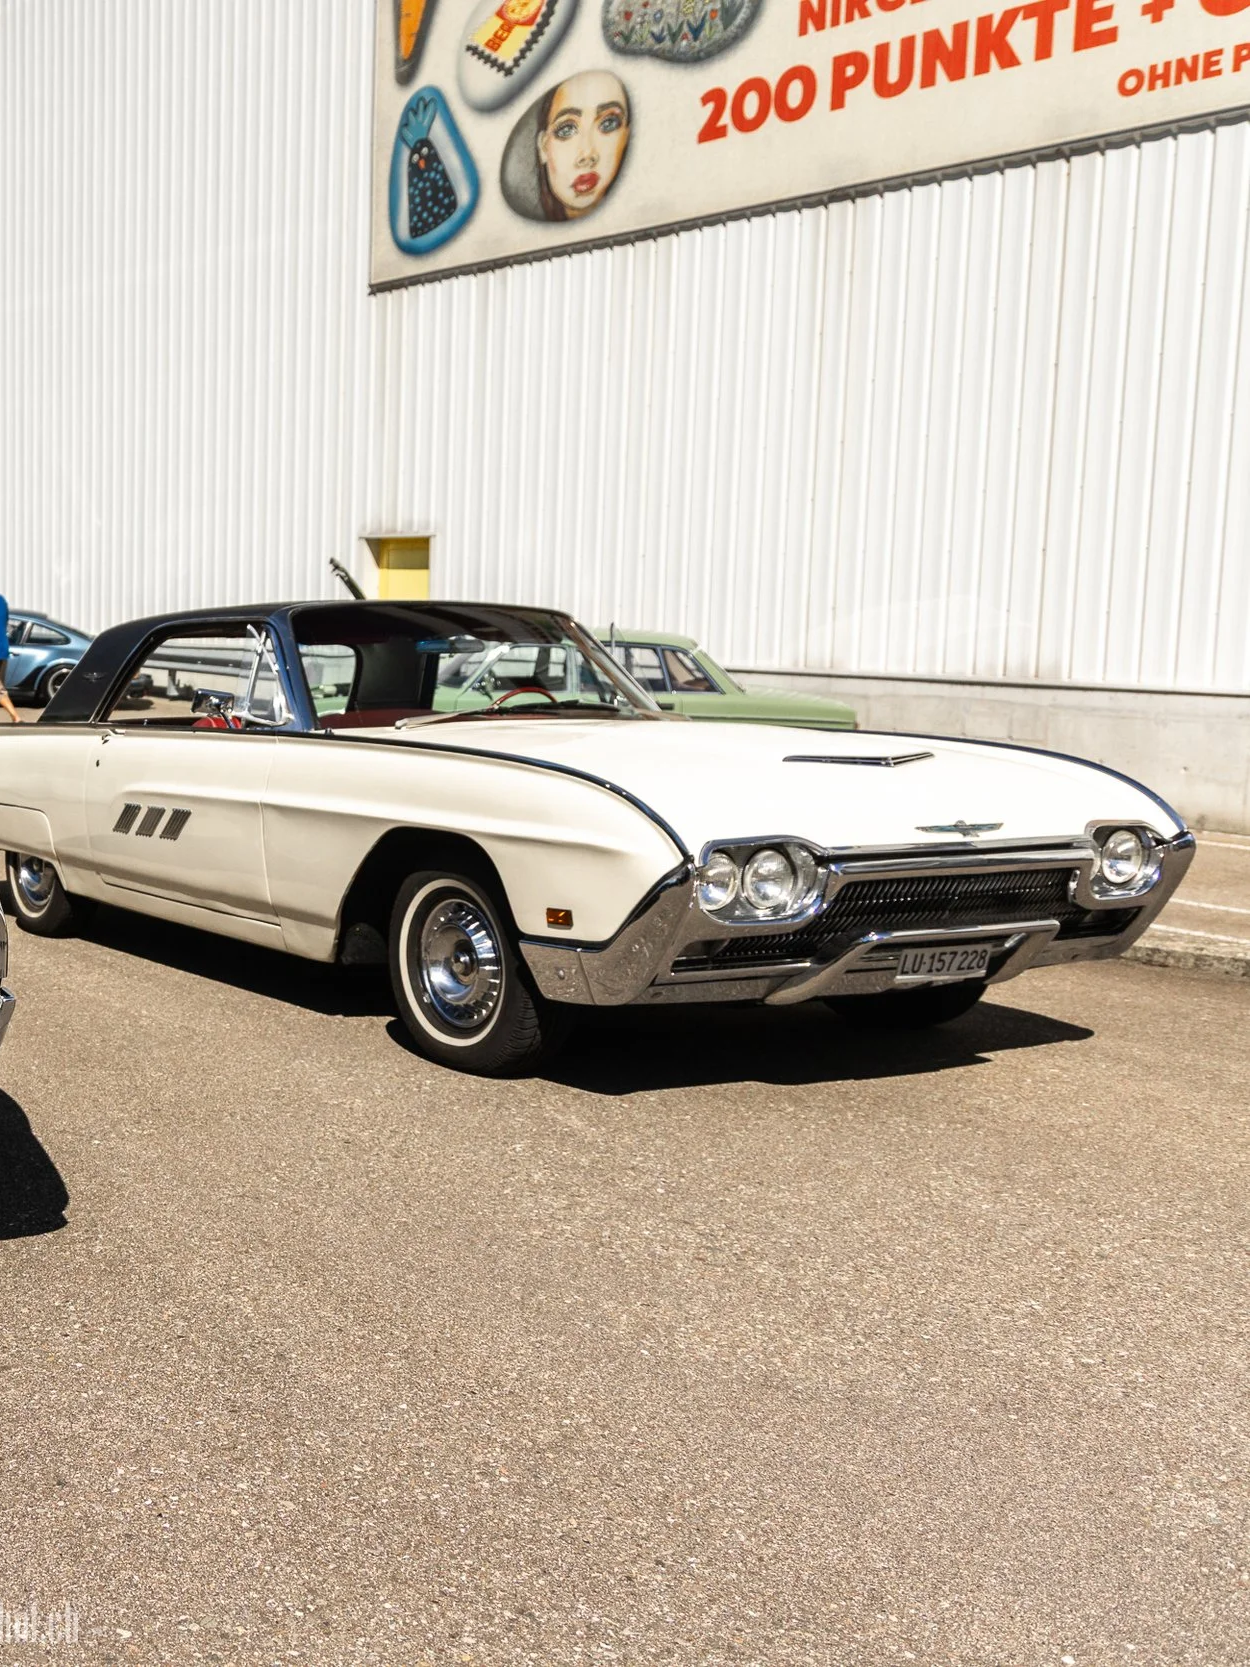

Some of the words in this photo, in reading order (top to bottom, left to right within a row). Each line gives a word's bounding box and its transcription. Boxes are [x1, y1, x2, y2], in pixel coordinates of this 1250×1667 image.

[697, 64, 817, 144] 200
[830, 0, 1119, 111] PUNKTE
[1117, 48, 1224, 97] OHNE
